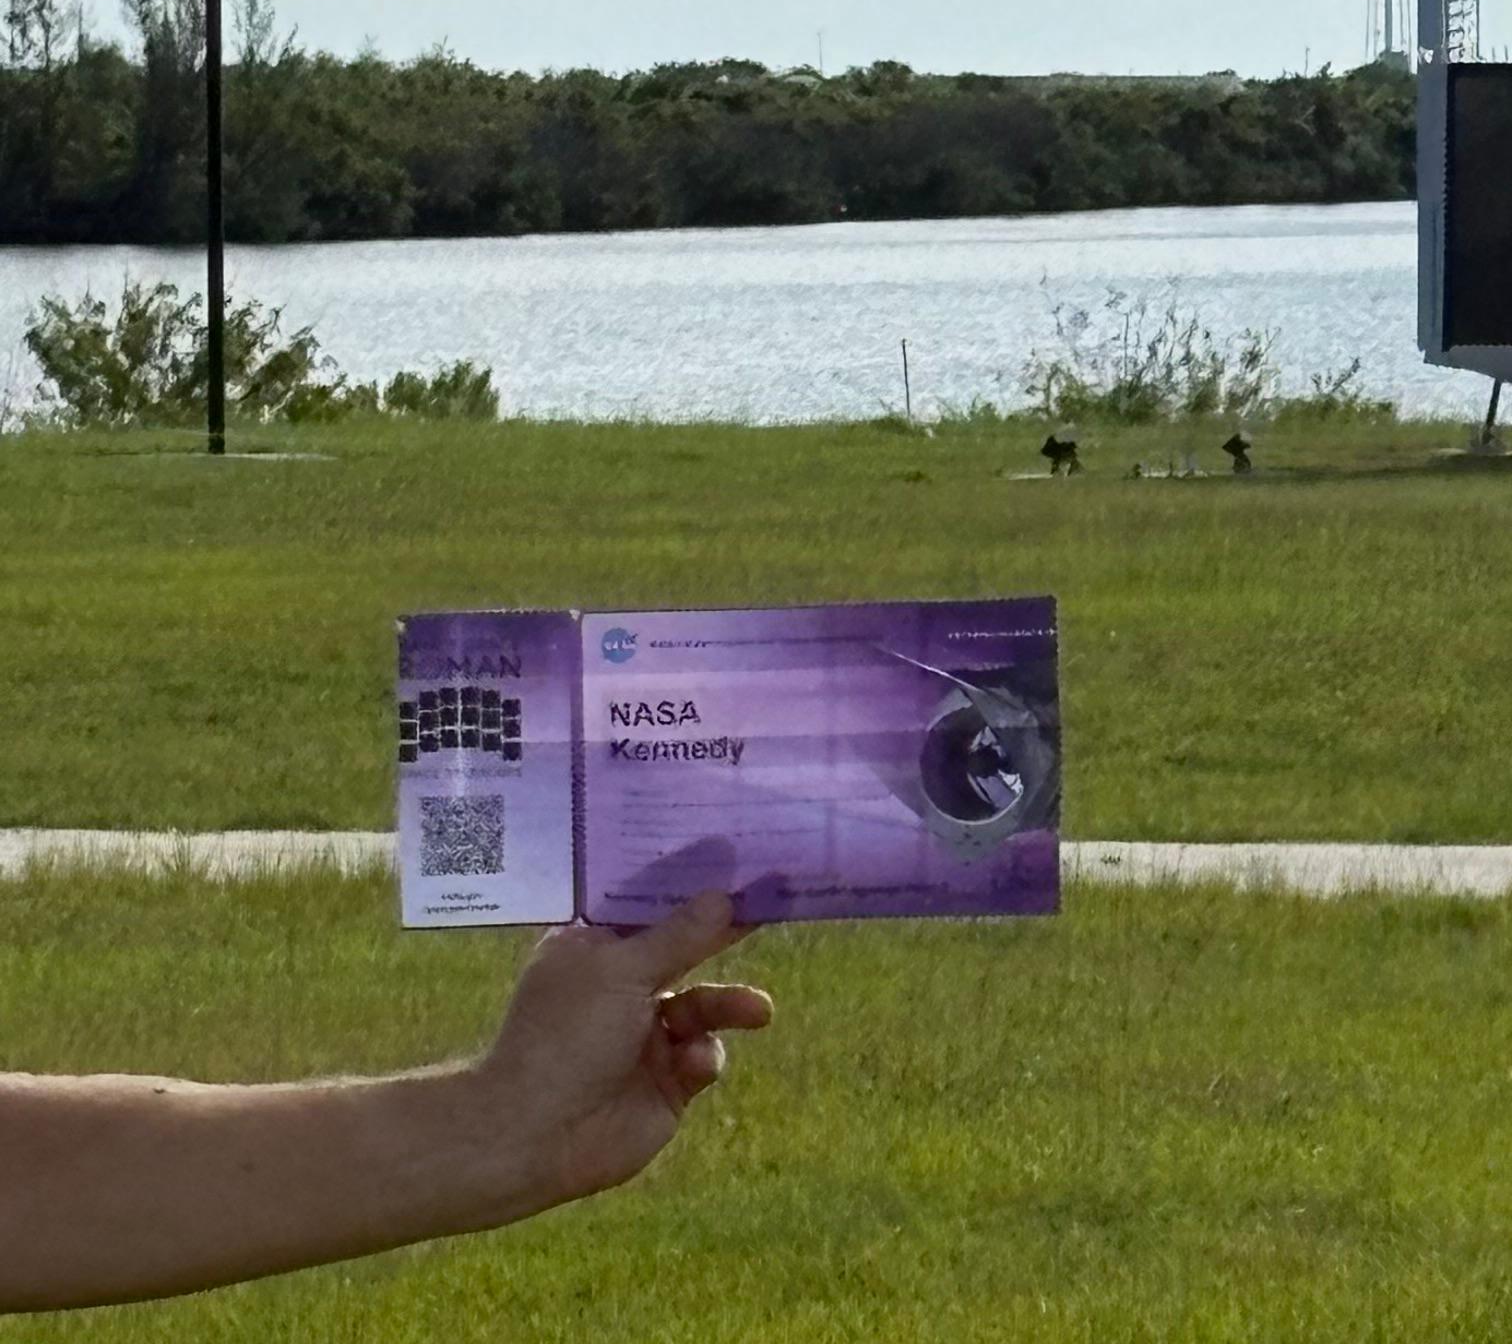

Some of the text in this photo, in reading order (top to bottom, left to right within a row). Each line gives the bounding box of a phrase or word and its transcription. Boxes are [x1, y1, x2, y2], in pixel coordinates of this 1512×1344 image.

[400, 655, 522, 680] MAN
[609, 700, 702, 727] NASA
[609, 737, 745, 766] Kennedy
